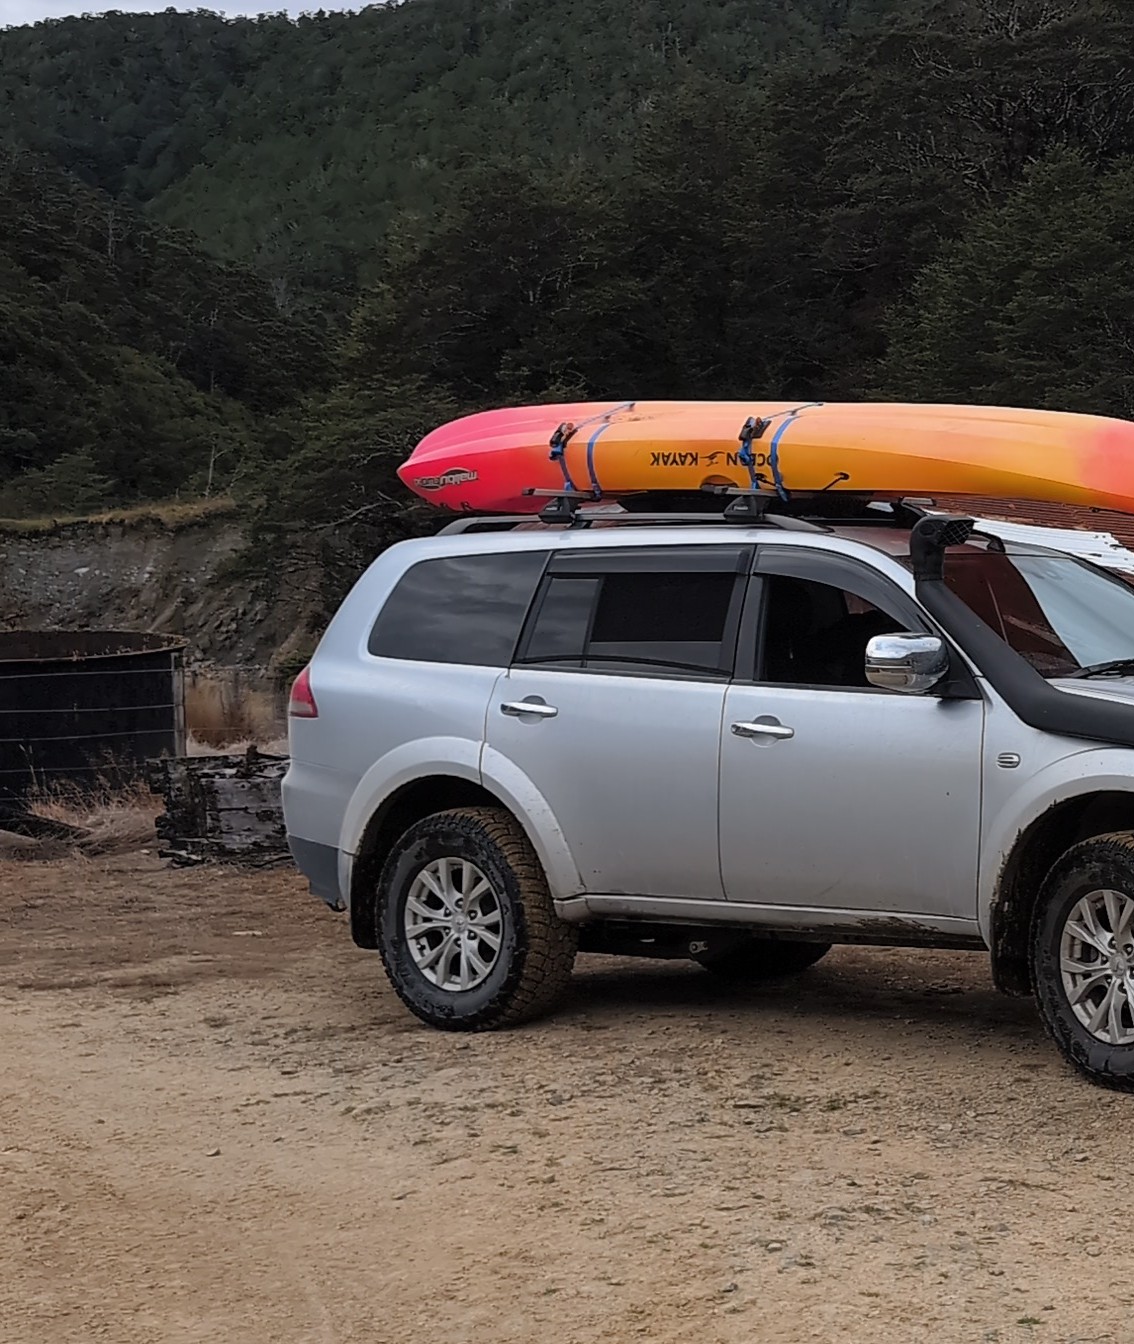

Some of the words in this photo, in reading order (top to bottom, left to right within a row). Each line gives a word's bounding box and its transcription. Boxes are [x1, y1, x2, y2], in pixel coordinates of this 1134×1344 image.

[650, 451, 699, 467] KAYAK
[726, 451, 779, 467] OCEN
[440, 471, 478, 486] malibu
